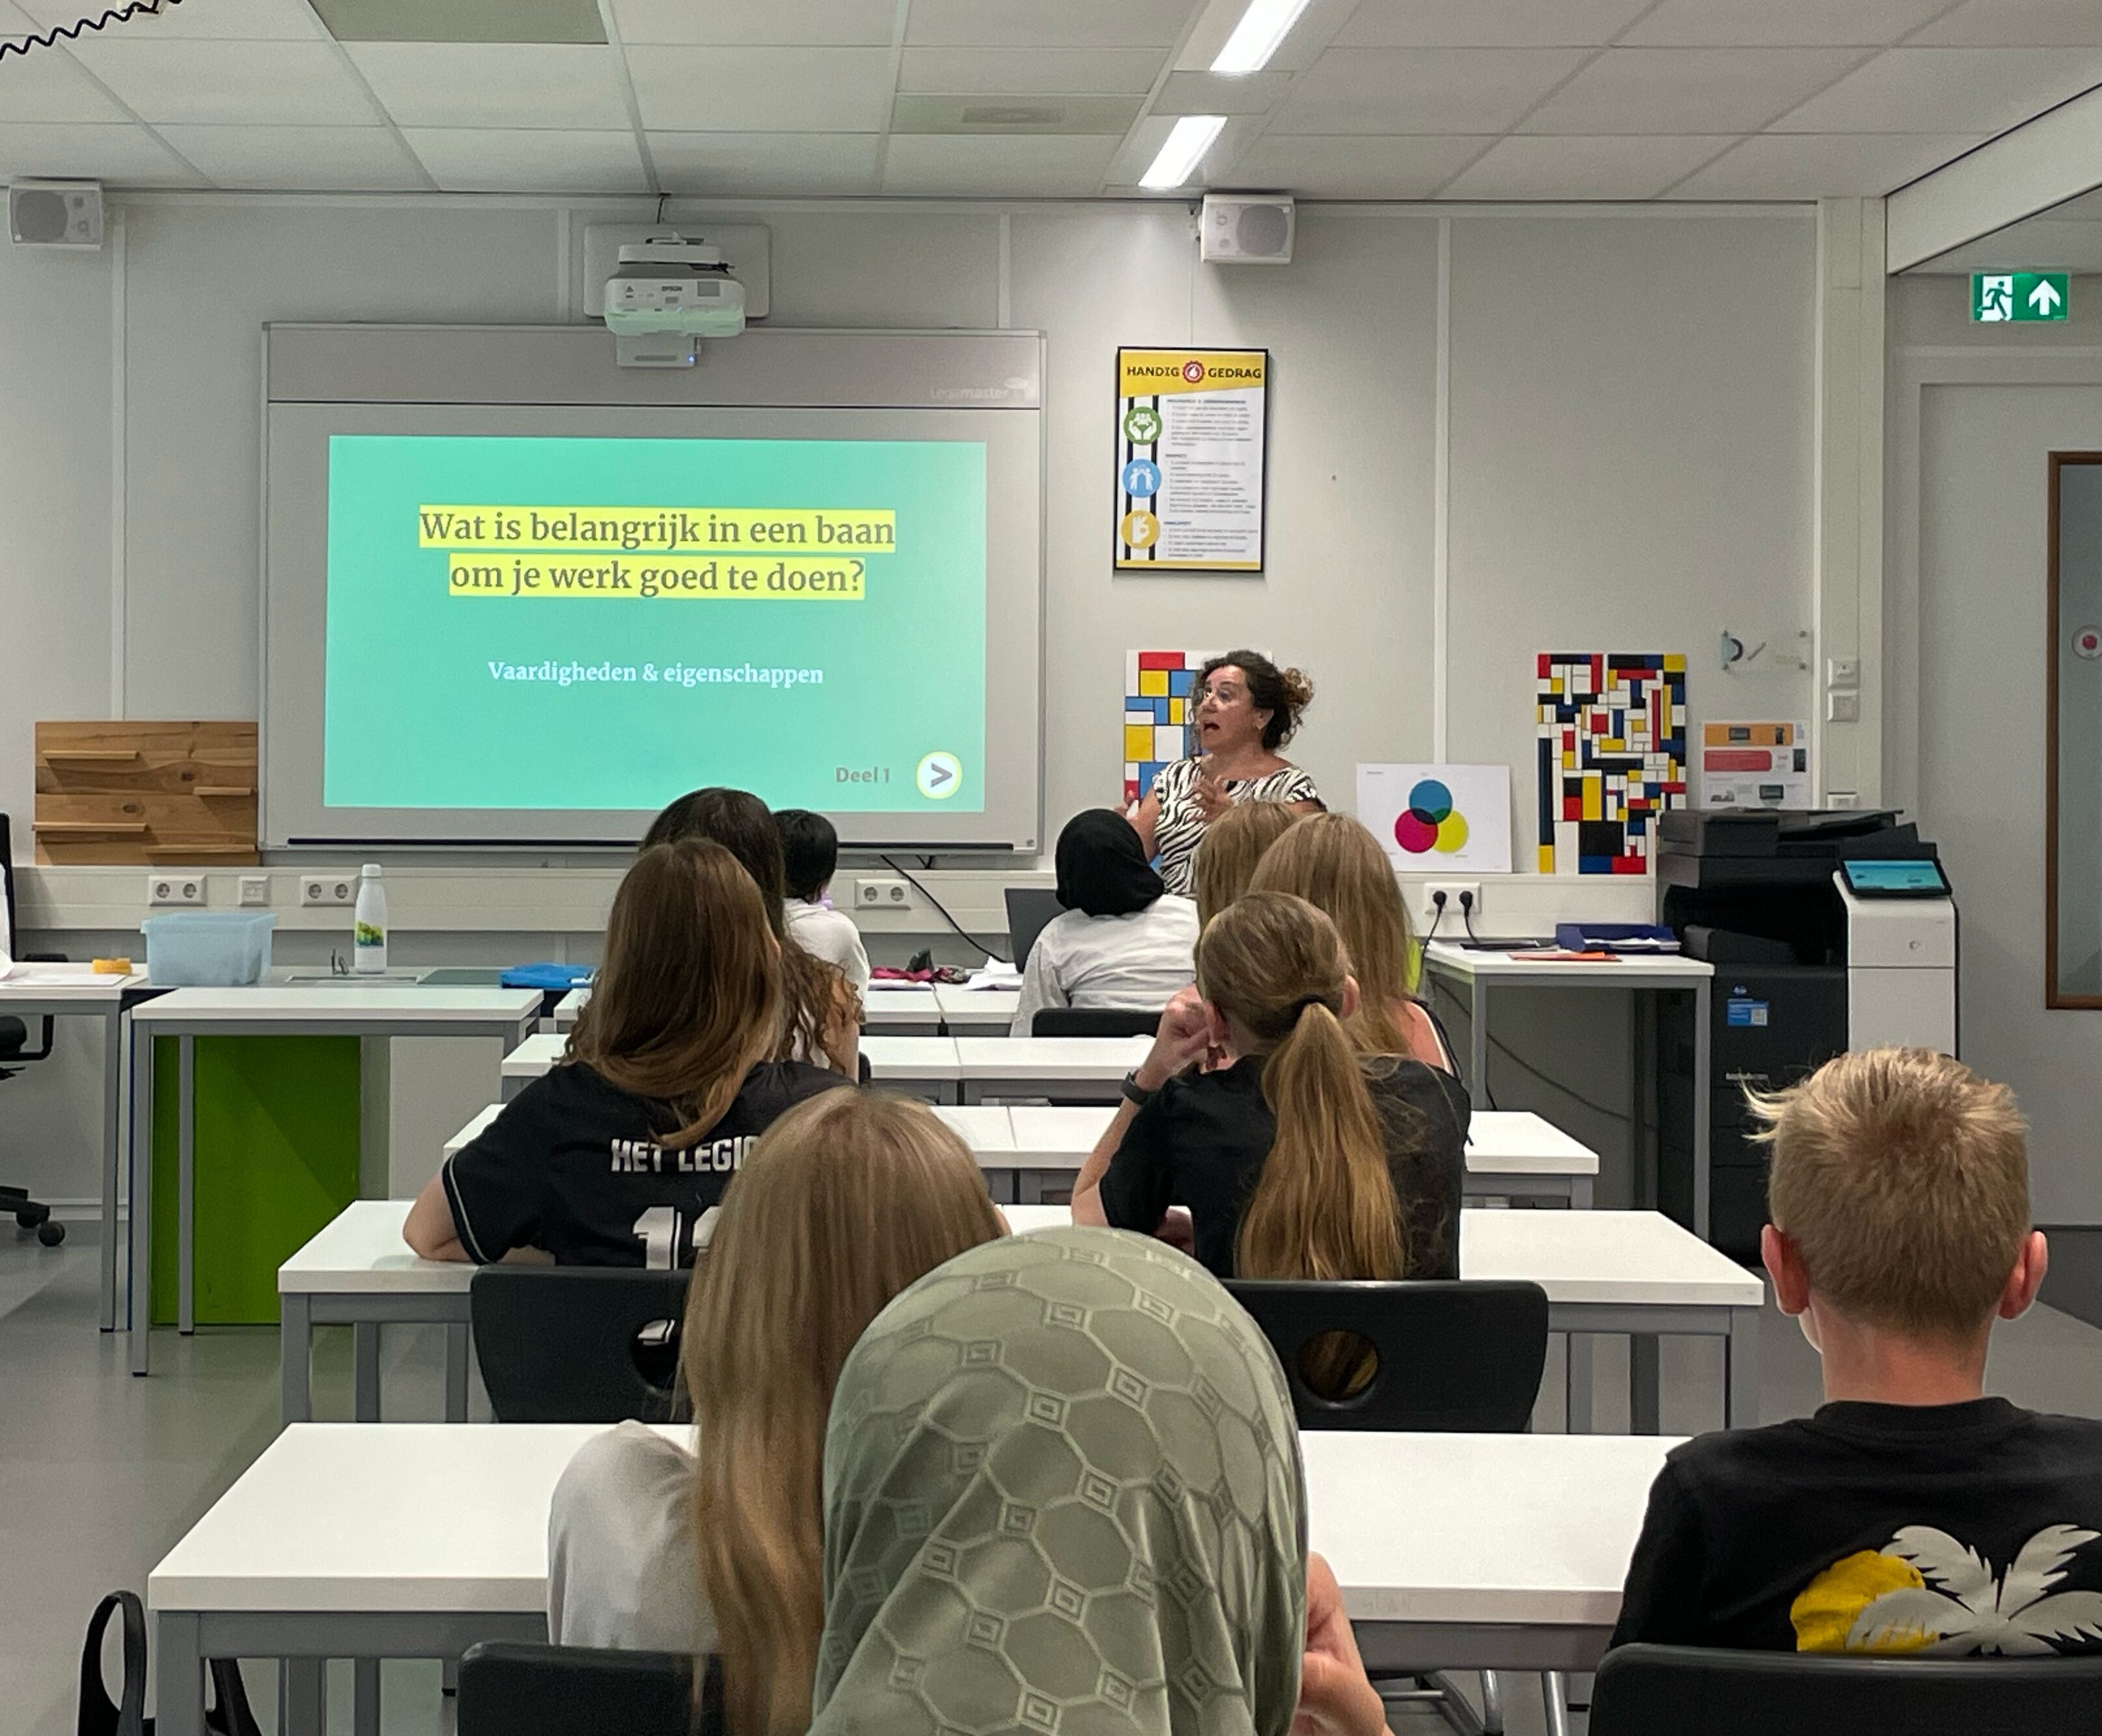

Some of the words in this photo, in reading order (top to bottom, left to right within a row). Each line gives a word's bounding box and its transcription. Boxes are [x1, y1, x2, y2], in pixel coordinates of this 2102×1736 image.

[1127, 366, 1180, 377] HANDIG
[1208, 367, 1262, 379] GEDRAG
[419, 512, 486, 540] Wat
[495, 512, 521, 540] is
[530, 512, 700, 550] belangrijk
[708, 514, 741, 543] in
[750, 521, 807, 544] een
[816, 515, 895, 545] baan
[451, 566, 504, 588] om
[512, 559, 541, 596] je
[549, 560, 633, 589] werk
[639, 562, 719, 598] goed
[727, 565, 758, 590] te
[767, 560, 865, 592] doen?
[487, 661, 637, 687] Vaardigheden
[642, 663, 659, 683] &
[663, 663, 823, 689] eigenschappen
[835, 765, 879, 783] Deel
[883, 767, 890, 783] 1
[611, 1138, 662, 1172] HET
